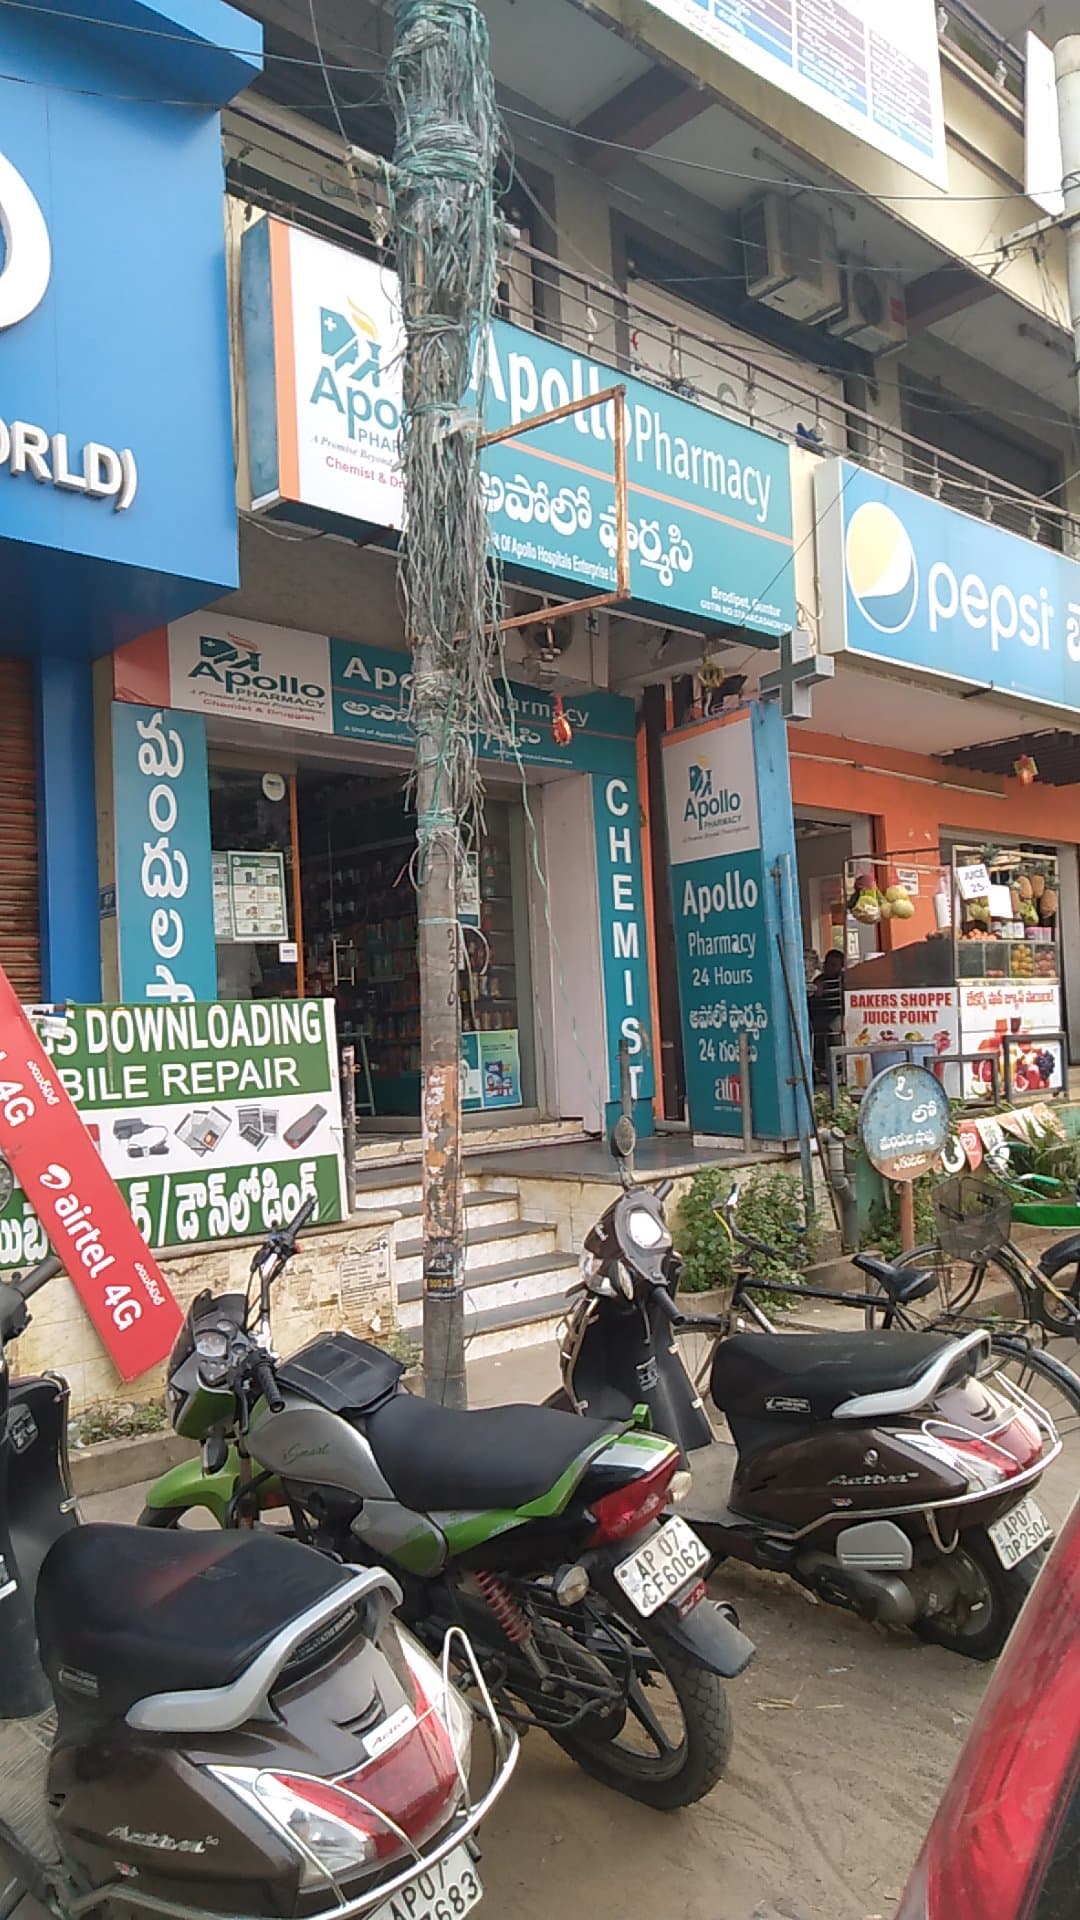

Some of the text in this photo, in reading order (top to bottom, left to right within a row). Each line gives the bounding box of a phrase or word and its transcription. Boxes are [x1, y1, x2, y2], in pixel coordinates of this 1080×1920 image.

[325, 455, 375, 481] Chemist
[378, 472, 387, 485] &
[635, 403, 772, 523] Pharmacy
[512, 537, 537, 560] Apollo
[537, 545, 572, 569] Hospitals
[928, 561, 1053, 652] pepsi
[188, 660, 326, 699] Apollo
[203, 699, 253, 712] Chemist
[235, 687, 326, 708] PHARMACY
[683, 788, 742, 831] Apollo
[964, 868, 985, 881] JUICE
[683, 870, 758, 923] Apollo
[605, 778, 644, 1100] CHEMIST
[687, 931, 756, 959] Pharmacy
[692, 966, 753, 987] 24 Hours
[850, 992, 952, 1008] BAKERS SHOPPE
[87, 1000, 322, 1054] DOWNLOADING
[863, 1010, 938, 1025] JUICE POINT
[698, 1038, 716, 1061] 24
[65, 1056, 301, 1103] BILE REPAIR
[54, 1192, 116, 1280] airtel
[104, 1283, 142, 1332] 4G
[634, 1550, 656, 1581] AP
